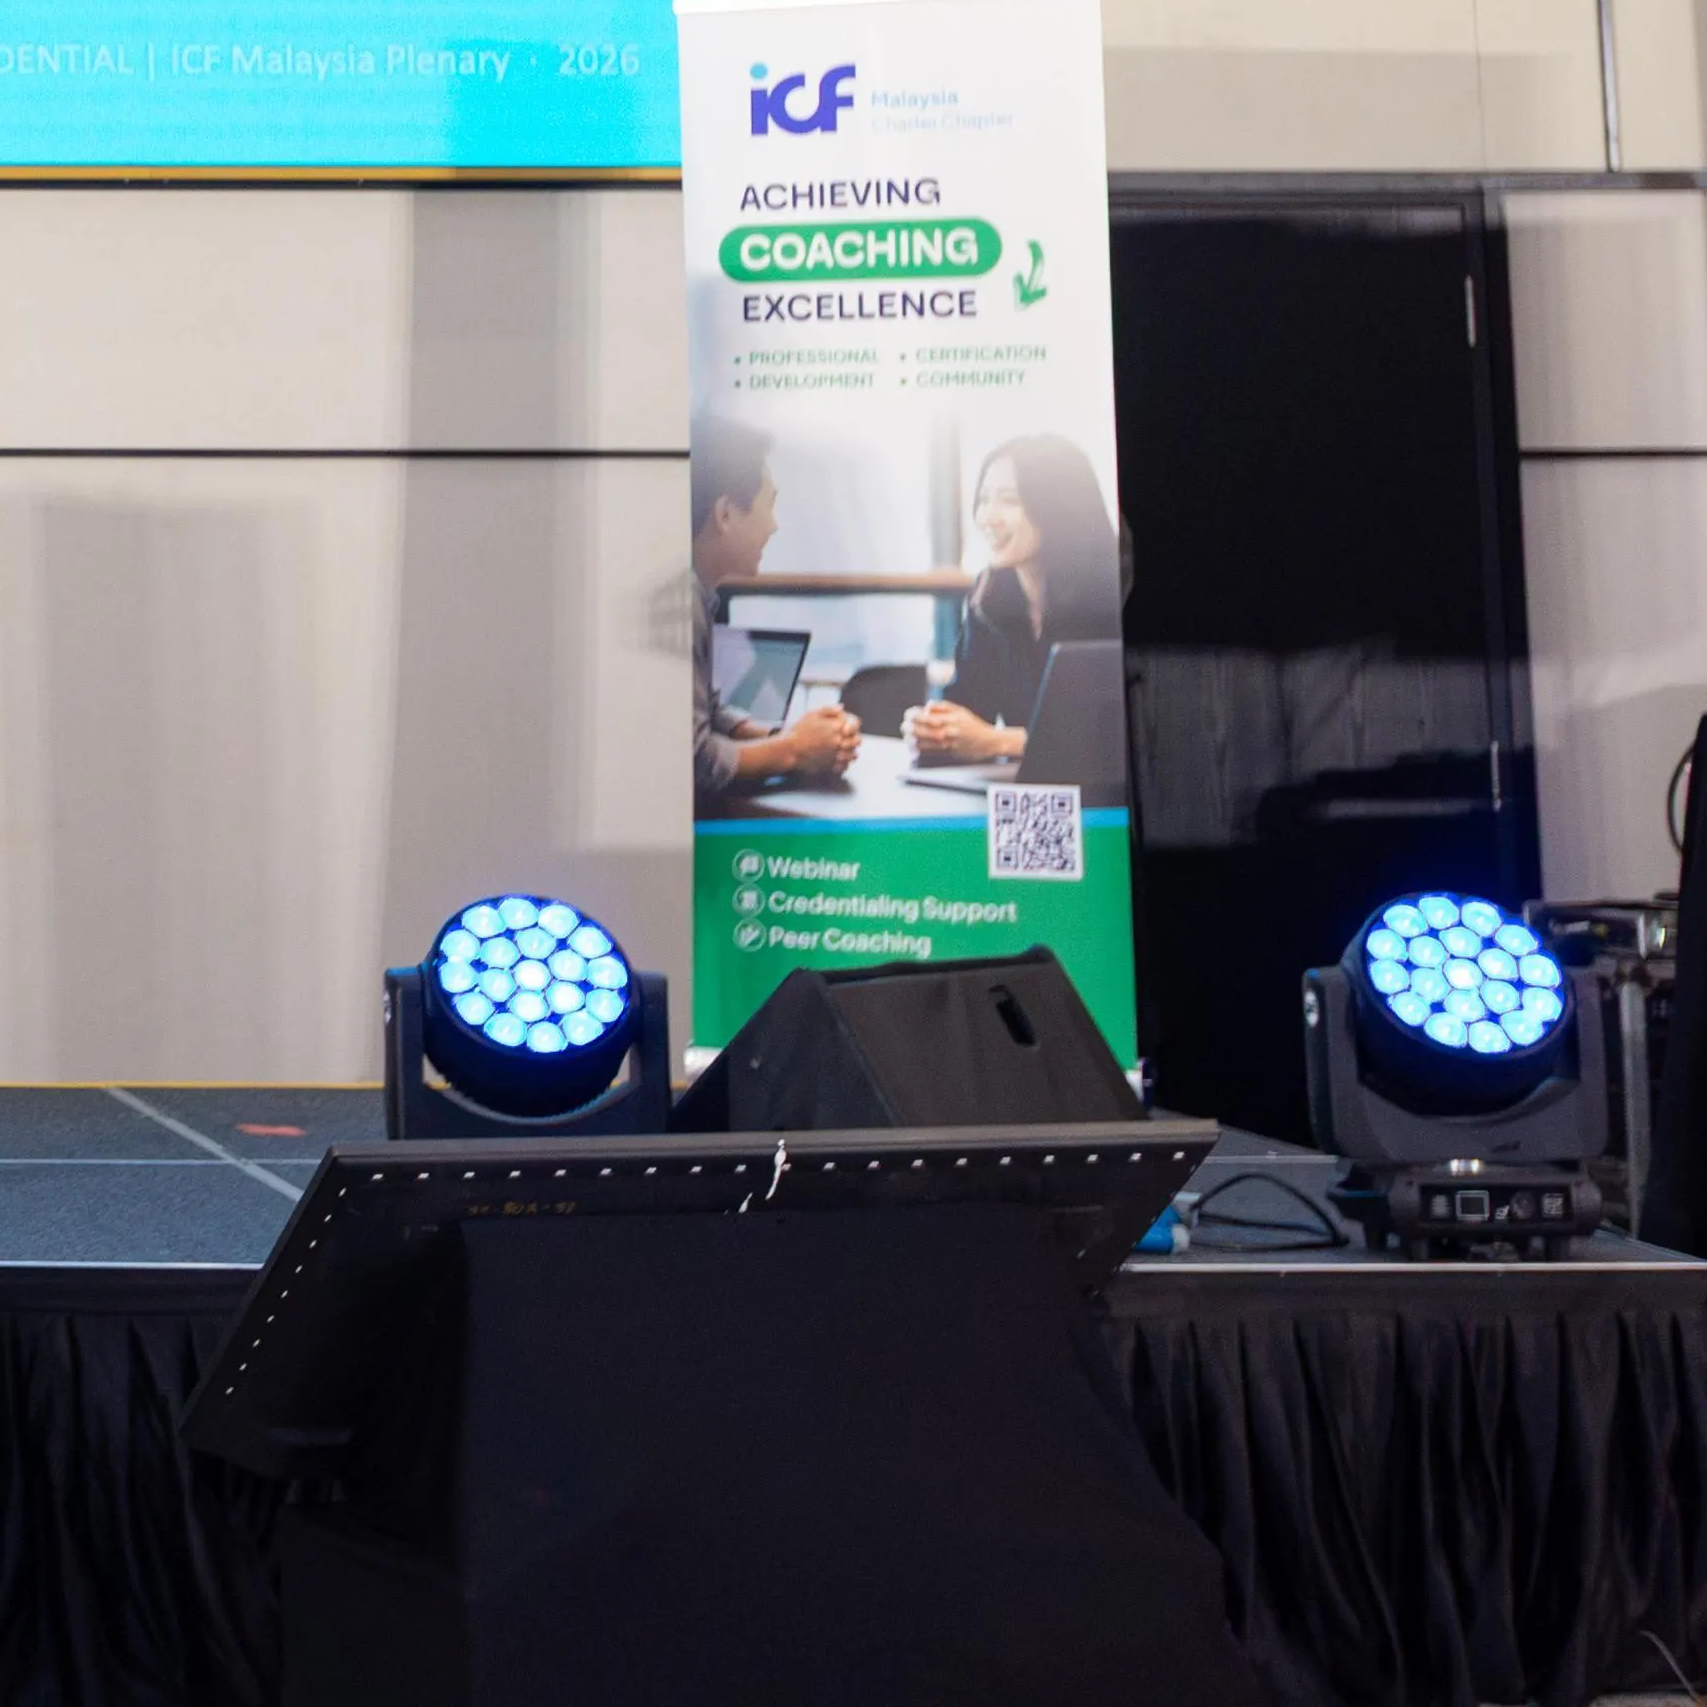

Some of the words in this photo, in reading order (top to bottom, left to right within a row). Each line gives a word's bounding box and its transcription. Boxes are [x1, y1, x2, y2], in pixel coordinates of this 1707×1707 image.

[172, 43, 219, 74] ICF
[233, 43, 376, 81] Malaysia
[387, 42, 511, 83] Plenary
[560, 43, 641, 76] 2026
[871, 89, 959, 111] Malaysia
[740, 176, 941, 210] ACHIEVING
[740, 229, 979, 271] COACHING
[743, 290, 978, 322] EXCELLENCE
[749, 349, 879, 365] PROFESSIONAL
[916, 346, 1046, 363] CERTIFICATION
[749, 373, 875, 389] DEVELOPMENT
[916, 370, 1025, 387] COMMUNITY
[767, 856, 860, 880] Webinar
[769, 890, 920, 924] Credentialing
[923, 901, 1017, 924] Support
[769, 928, 819, 948] Peer
[823, 929, 931, 958] Coaching
